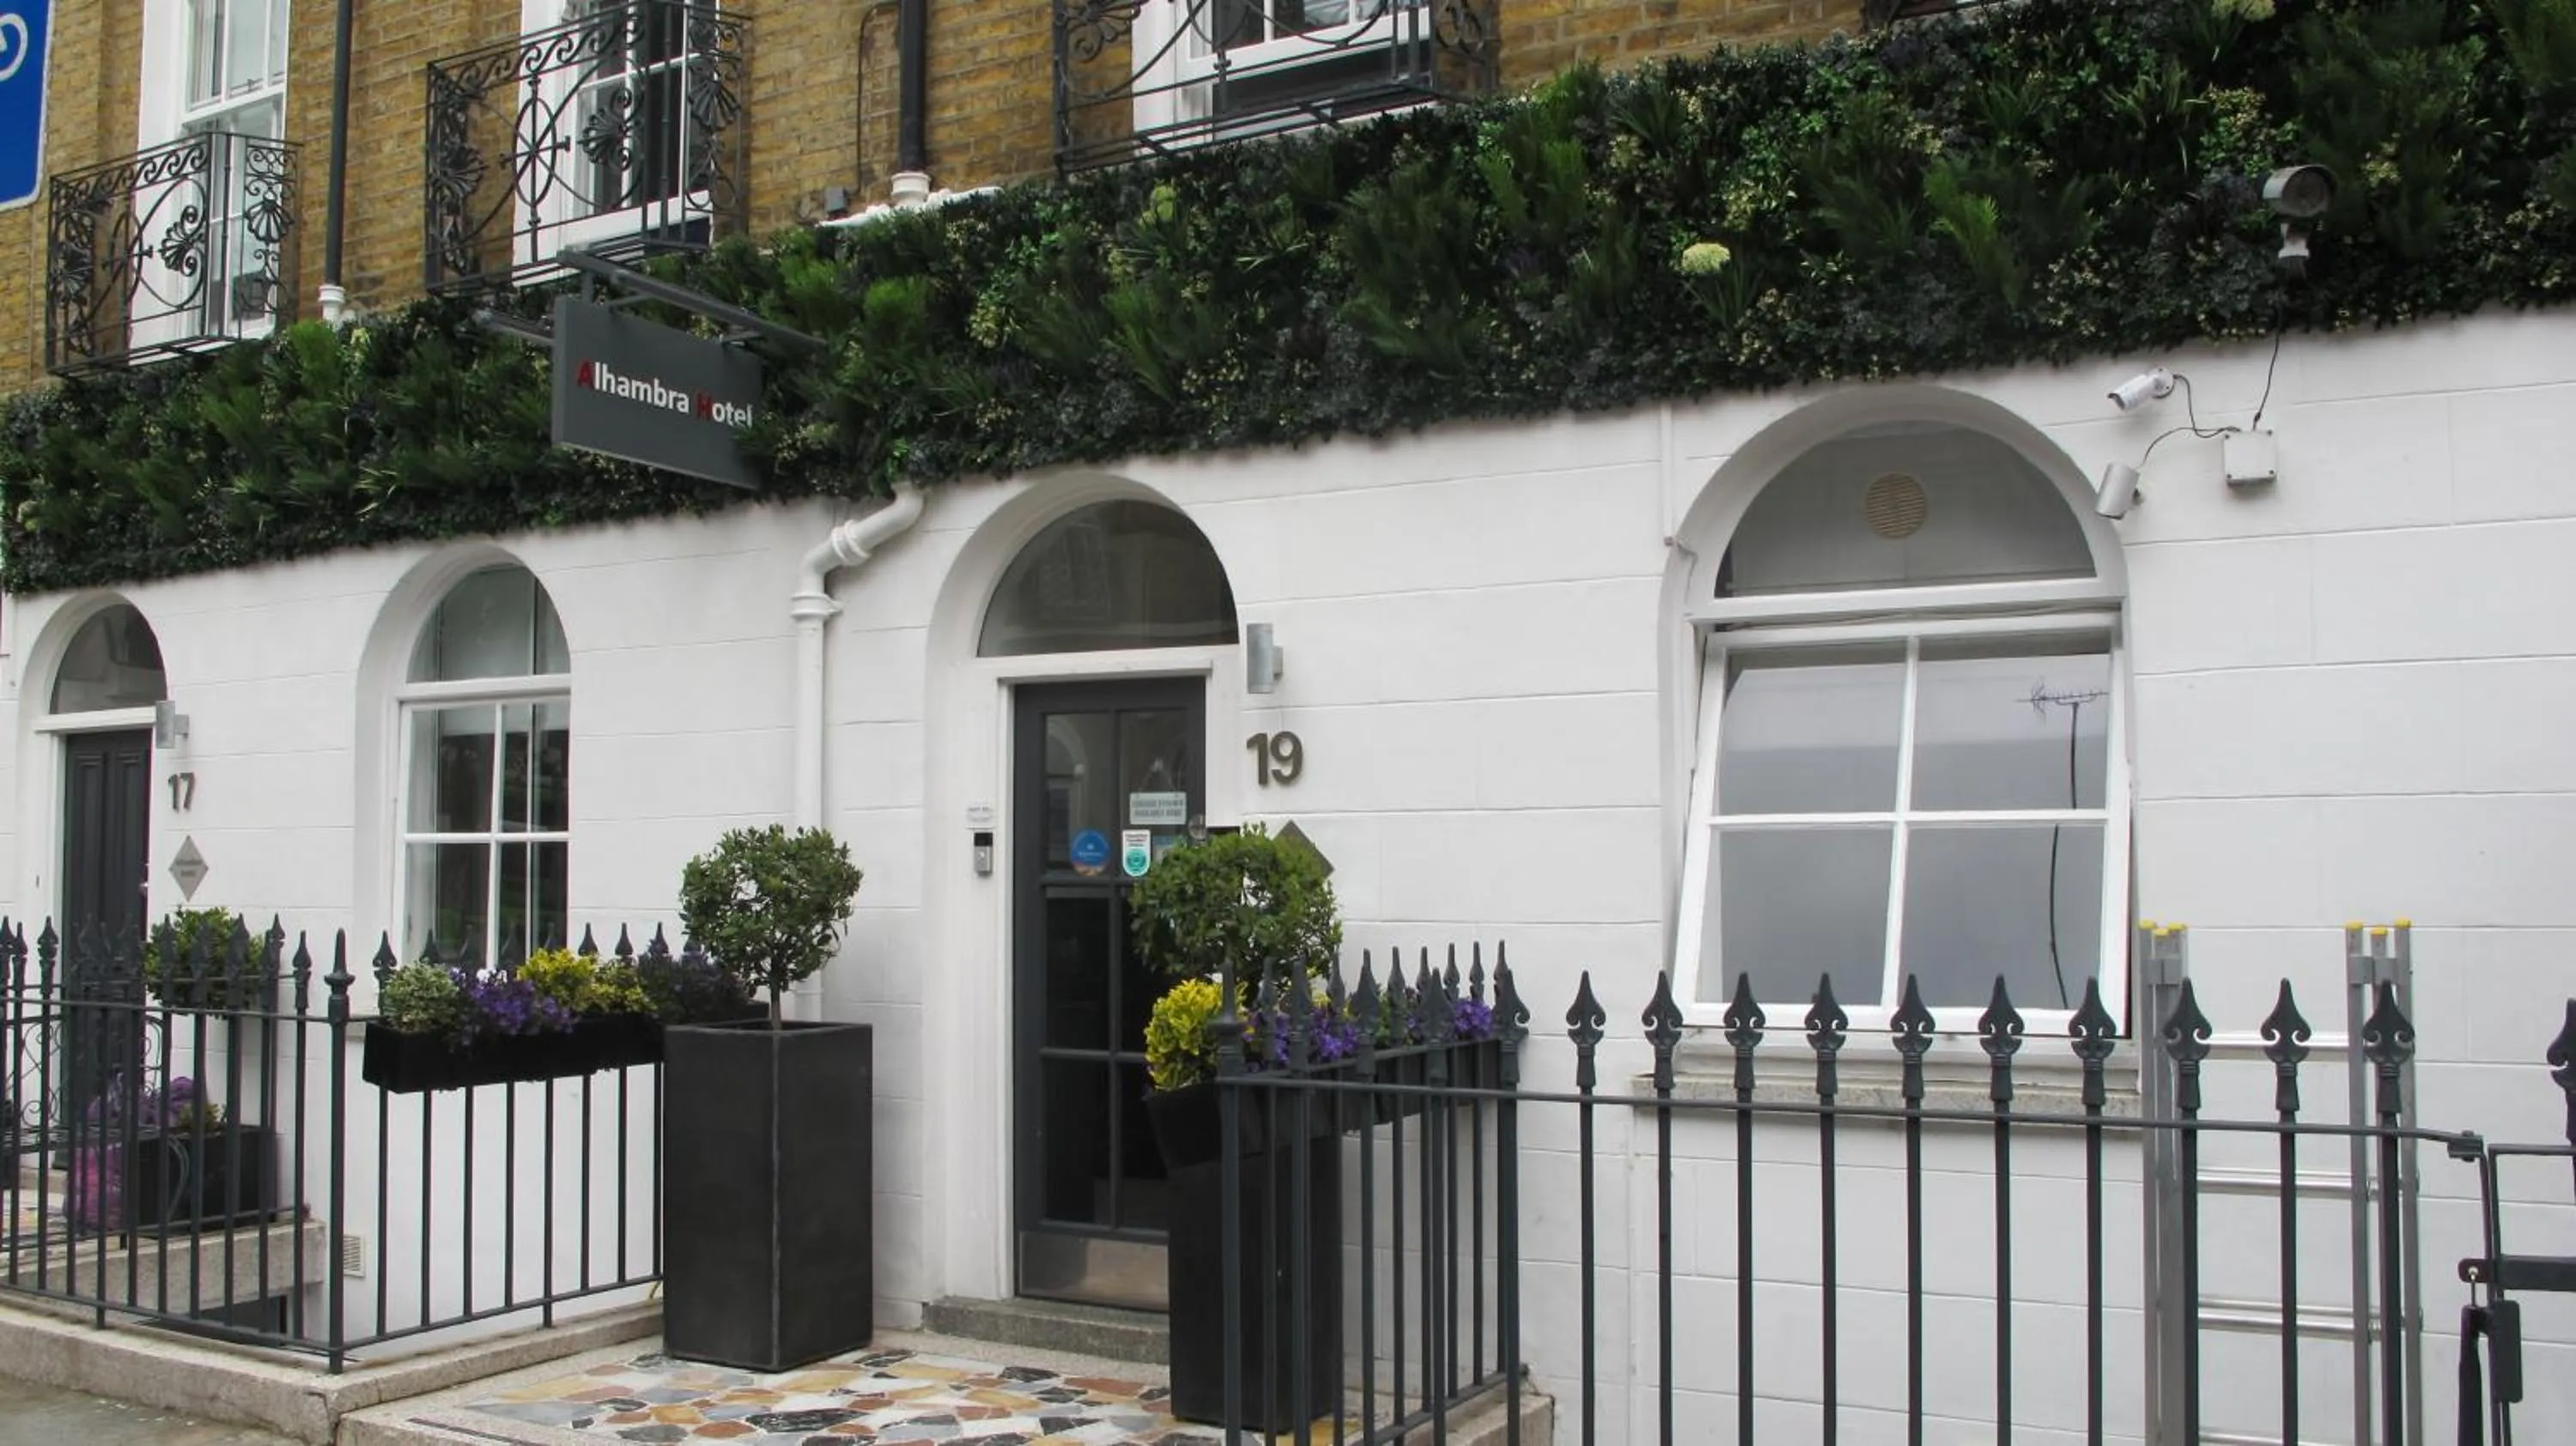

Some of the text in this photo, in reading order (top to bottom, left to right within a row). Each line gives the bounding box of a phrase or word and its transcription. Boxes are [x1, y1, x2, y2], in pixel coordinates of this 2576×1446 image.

[578, 360, 753, 428] Alhambra Hotel
[1246, 730, 1304, 787] 19
[167, 772, 196, 812] 17
